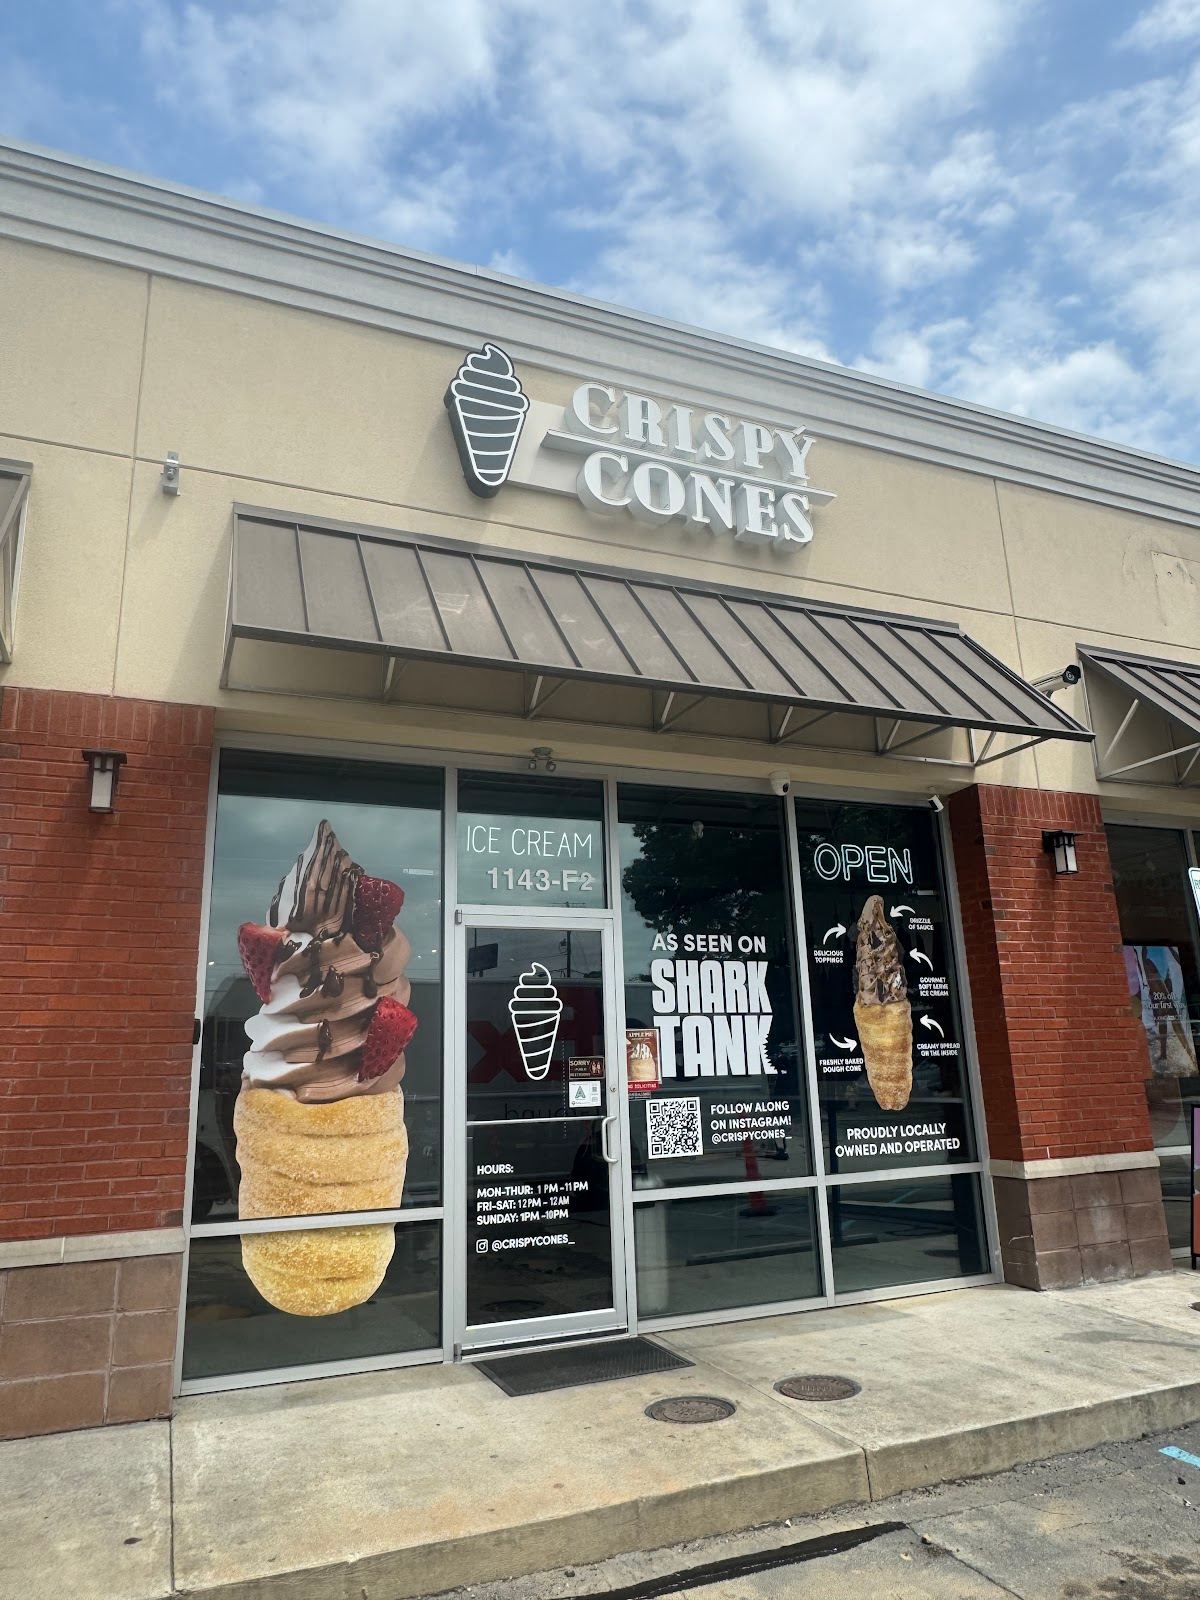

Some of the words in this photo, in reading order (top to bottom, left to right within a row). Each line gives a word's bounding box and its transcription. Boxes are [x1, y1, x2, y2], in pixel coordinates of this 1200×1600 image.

[570, 382, 816, 480] CRISPY
[582, 450, 814, 544] CONES
[466, 825, 501, 854] ICE
[511, 828, 592, 859] CREAM
[814, 842, 913, 884] OPEN
[487, 867, 593, 891] 1143-F2
[652, 933, 678, 951] AS
[683, 934, 733, 952] SEEN
[737, 935, 766, 953] ON
[651, 958, 773, 1014] SHARK
[653, 1014, 778, 1078] TANK
[819, 1058, 844, 1066] FRESHLY
[844, 1057, 864, 1065] BAKED
[823, 1065, 845, 1073] DOUGH
[845, 1064, 862, 1072] CONE
[710, 1103, 753, 1115] FOLLOW
[754, 1101, 790, 1112] ALONG
[710, 1120, 727, 1131] ON
[728, 1115, 792, 1129] INSTAGRAM!
[846, 1125, 899, 1140] PROUDLY
[900, 1122, 947, 1137] LOCALLY
[711, 1129, 793, 1145] @CRISPYCONES_
[835, 1143, 878, 1158] OWNED
[879, 1141, 903, 1155] AND
[904, 1137, 961, 1153] OPERATED
[476, 1163, 514, 1175] HOURS:
[476, 1185, 534, 1199] MON-THUR:
[476, 1199, 517, 1212] FRI-SAT:
[476, 1213, 519, 1226] SUNDAY:
[491, 1234, 576, 1252] @CRISPYCONES_
